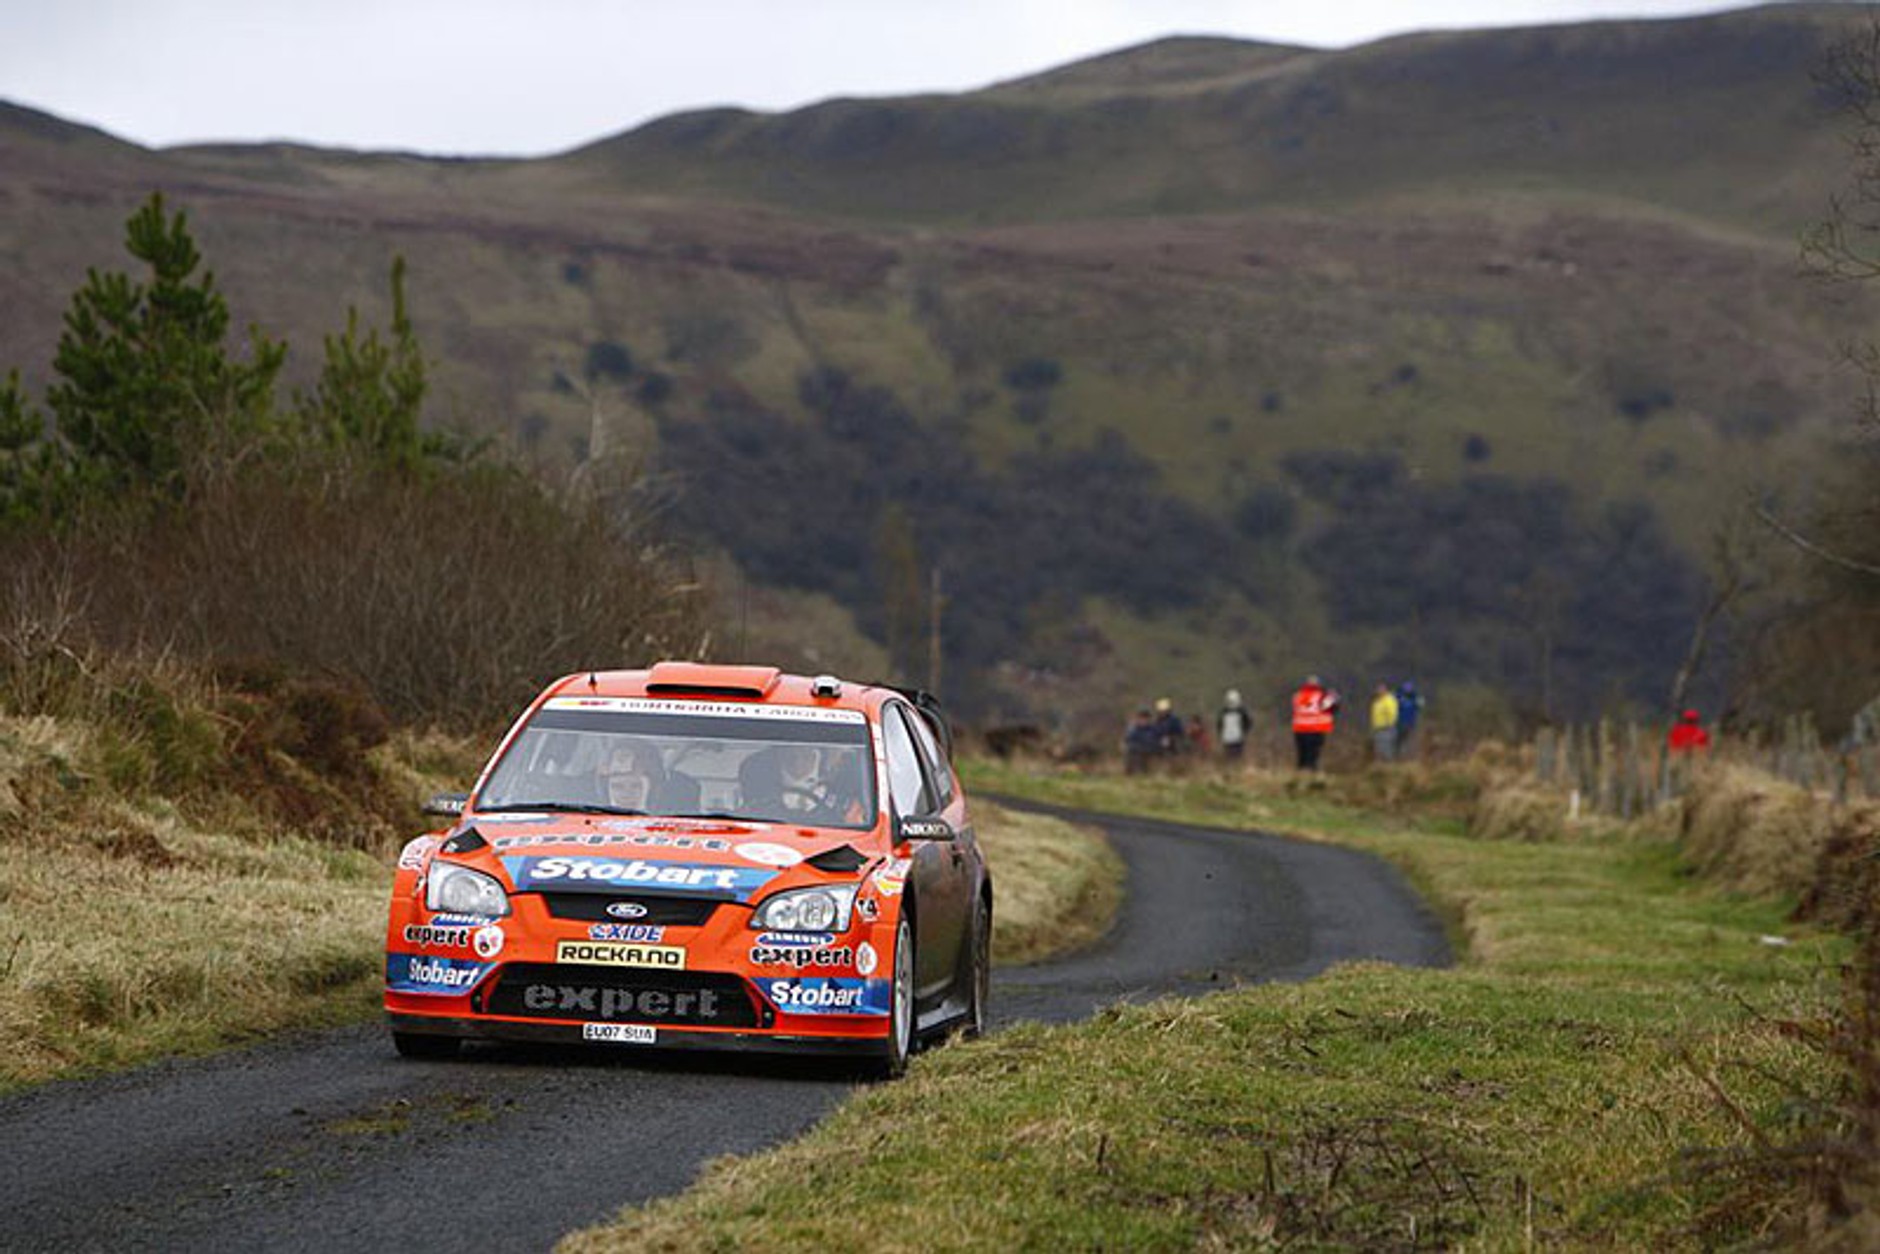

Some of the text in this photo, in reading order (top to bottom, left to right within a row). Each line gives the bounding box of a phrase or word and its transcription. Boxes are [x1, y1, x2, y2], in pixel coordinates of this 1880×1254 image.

[530, 858, 738, 889] Stobart
[749, 946, 852, 968] expert
[408, 958, 479, 985] Stobart
[524, 984, 719, 1018] expert
[770, 980, 863, 1006] Stobart
